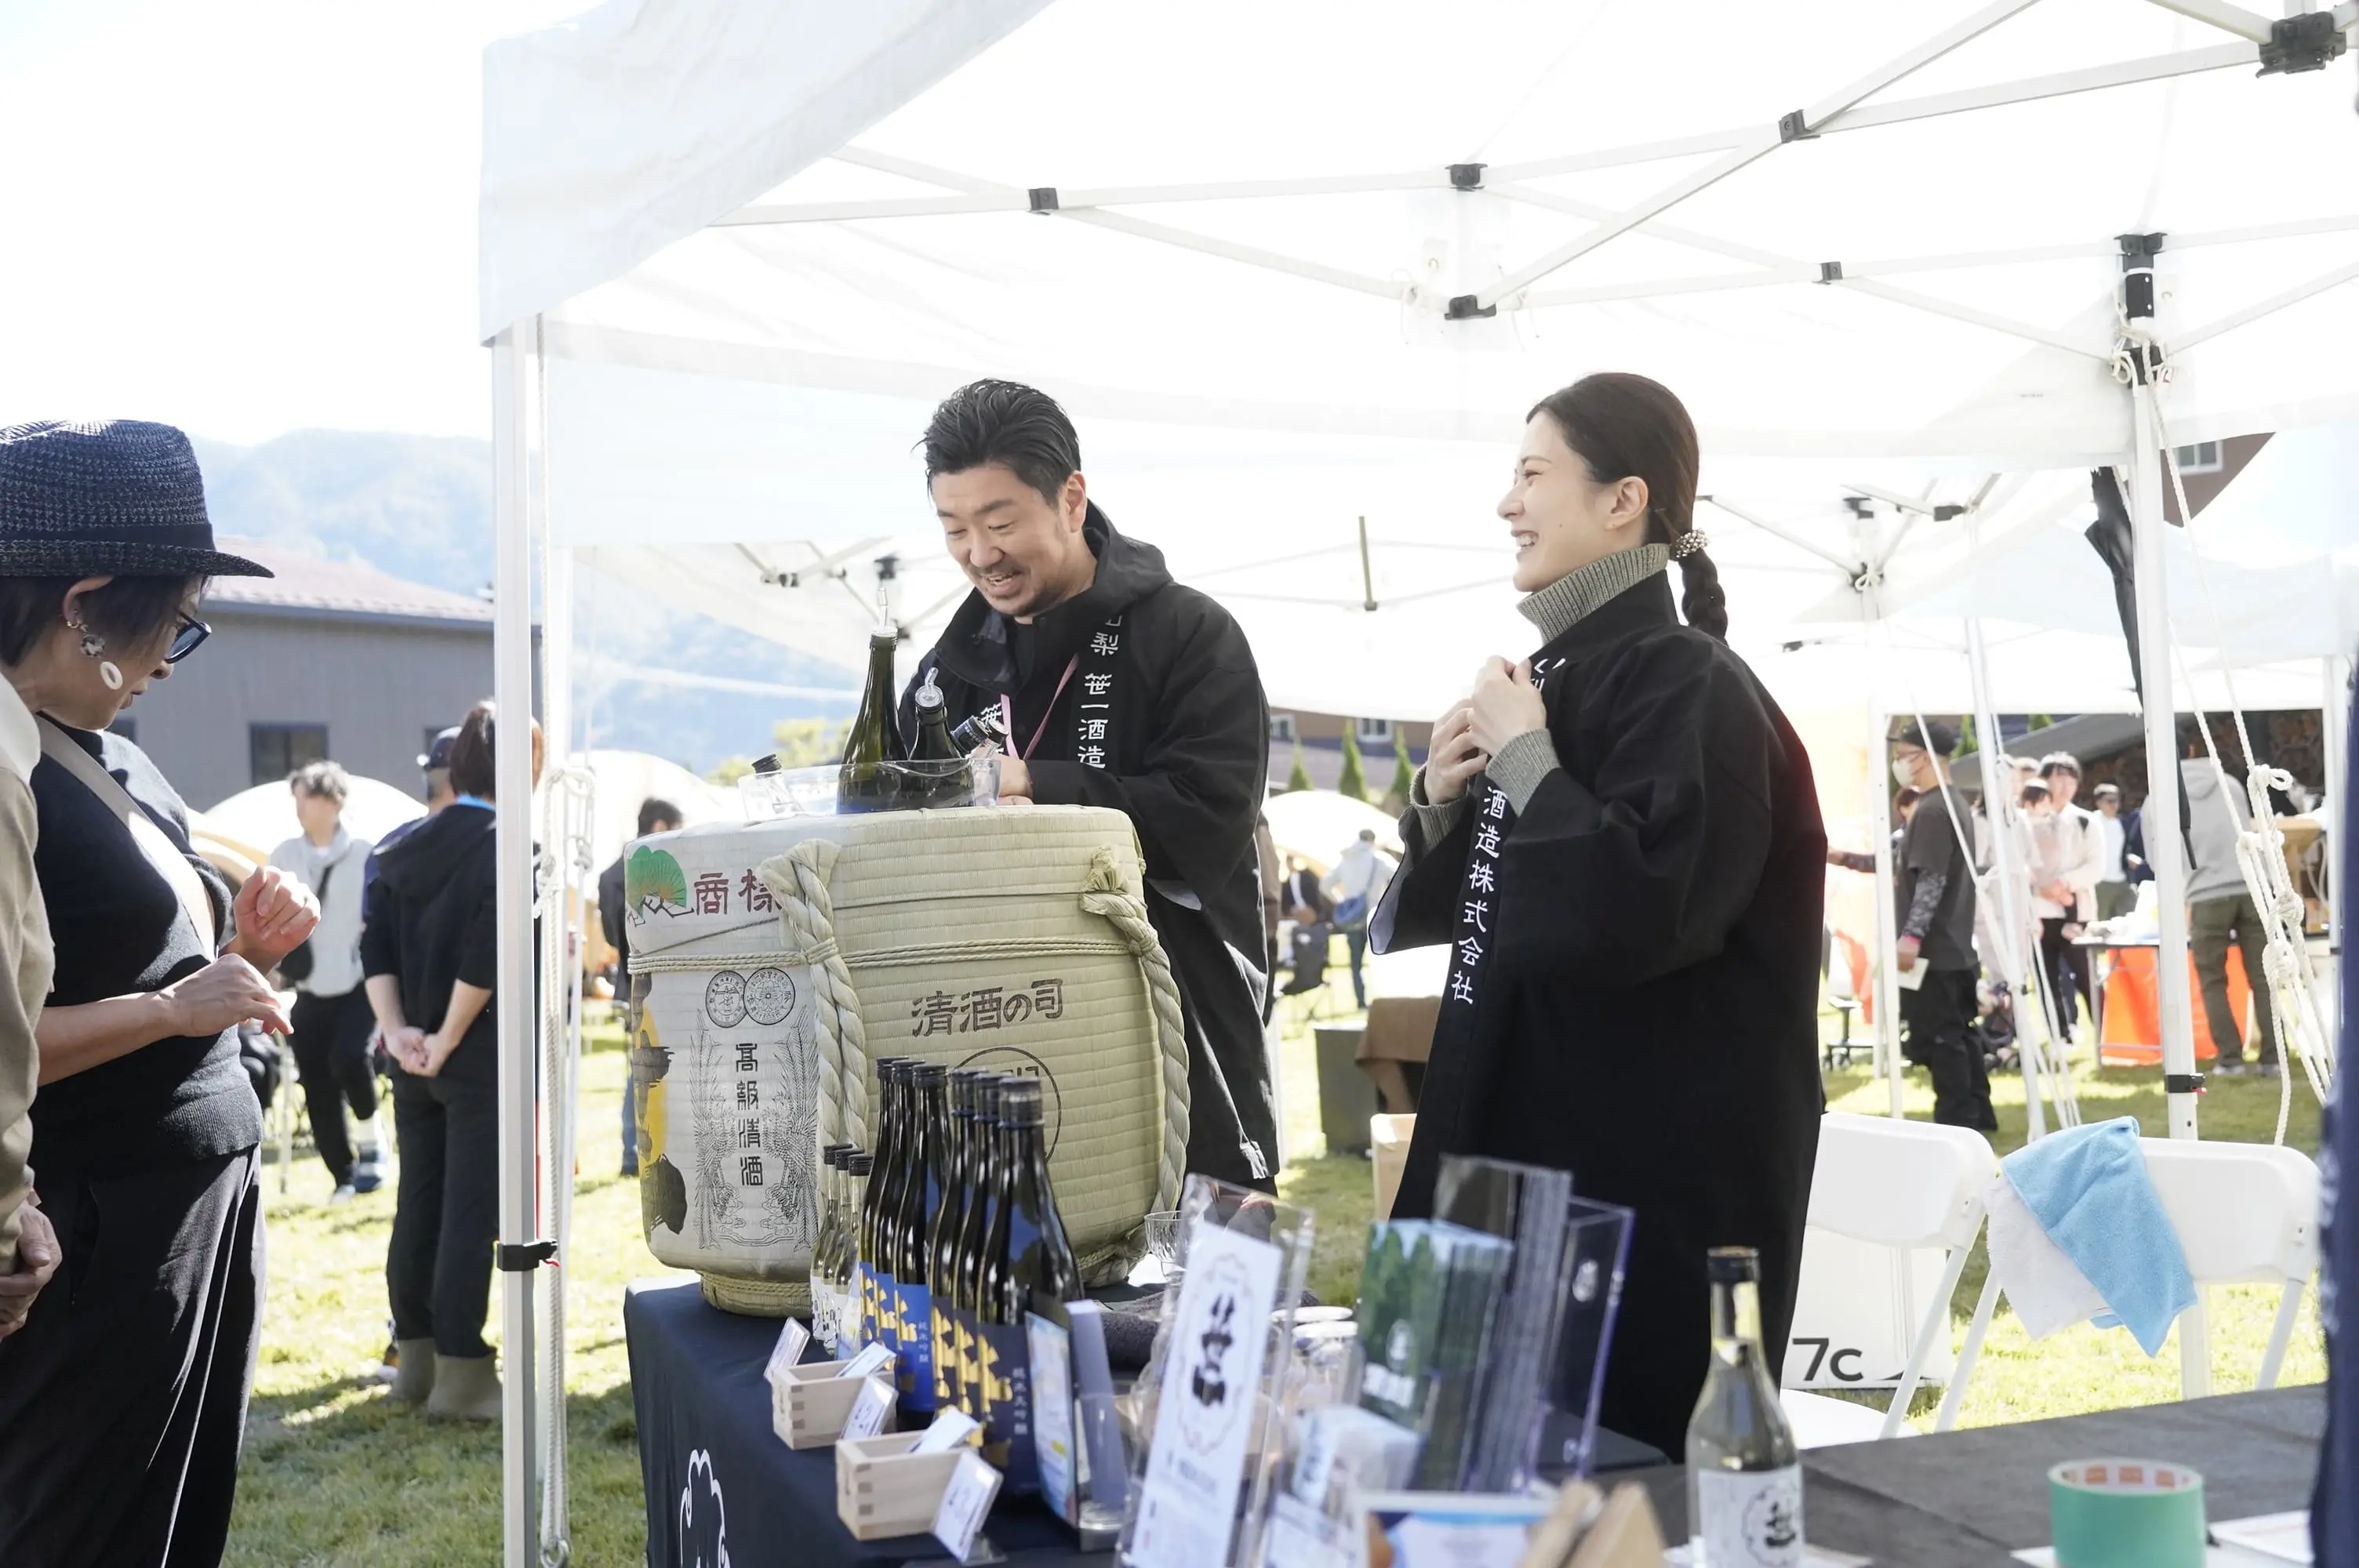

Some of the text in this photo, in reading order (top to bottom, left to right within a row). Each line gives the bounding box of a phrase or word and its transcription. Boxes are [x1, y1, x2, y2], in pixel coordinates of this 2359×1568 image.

[1451, 786, 1509, 1005] 酒造株式会社
[911, 978, 1064, 1038] 清酒の司
